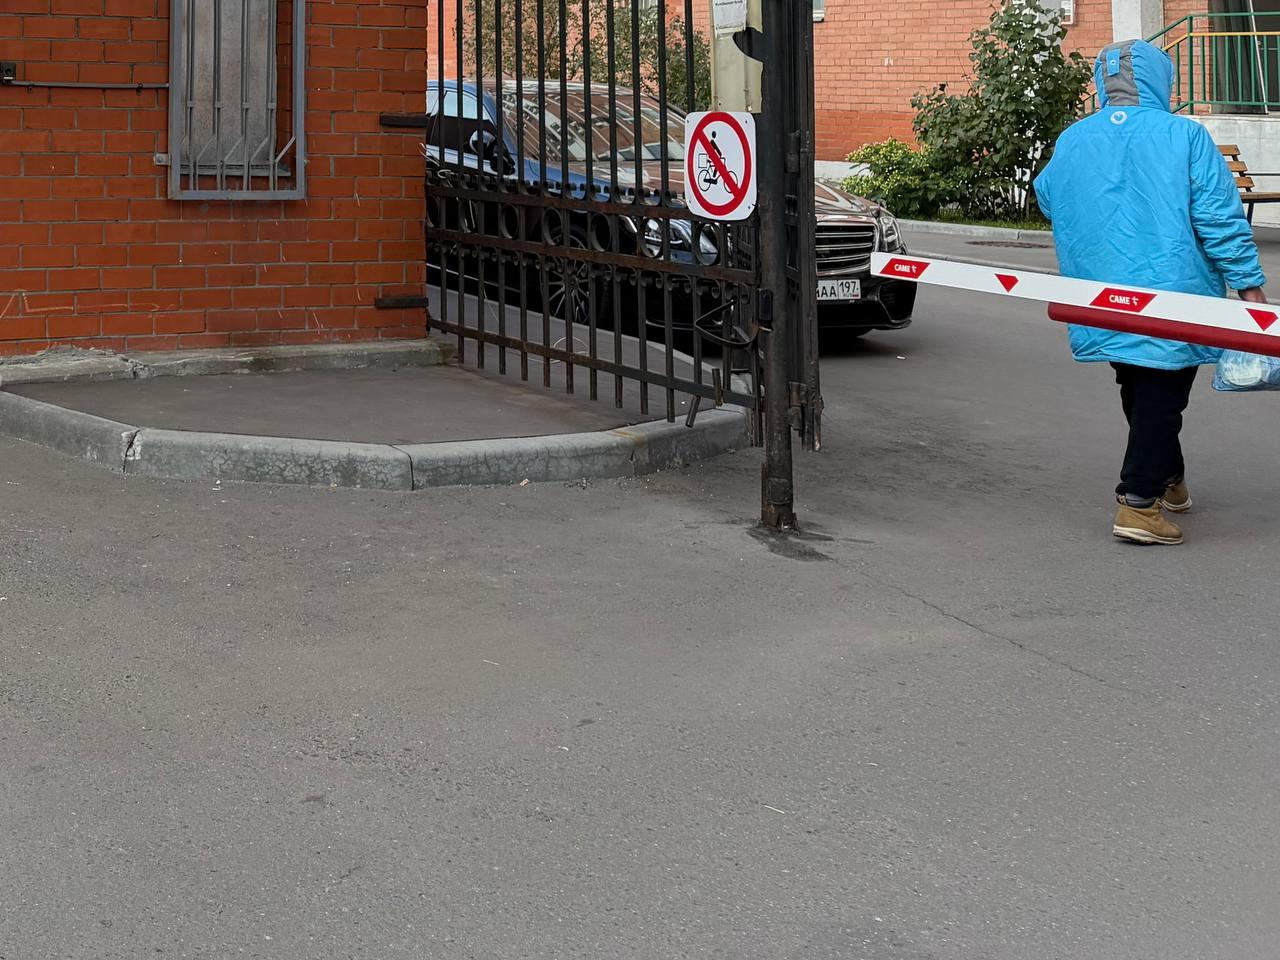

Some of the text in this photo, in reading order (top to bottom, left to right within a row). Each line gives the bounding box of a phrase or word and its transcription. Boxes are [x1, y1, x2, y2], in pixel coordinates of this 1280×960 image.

[894, 263, 911, 273] CAME
[839, 280, 856, 293] 197
[1109, 294, 1131, 305] CAME
